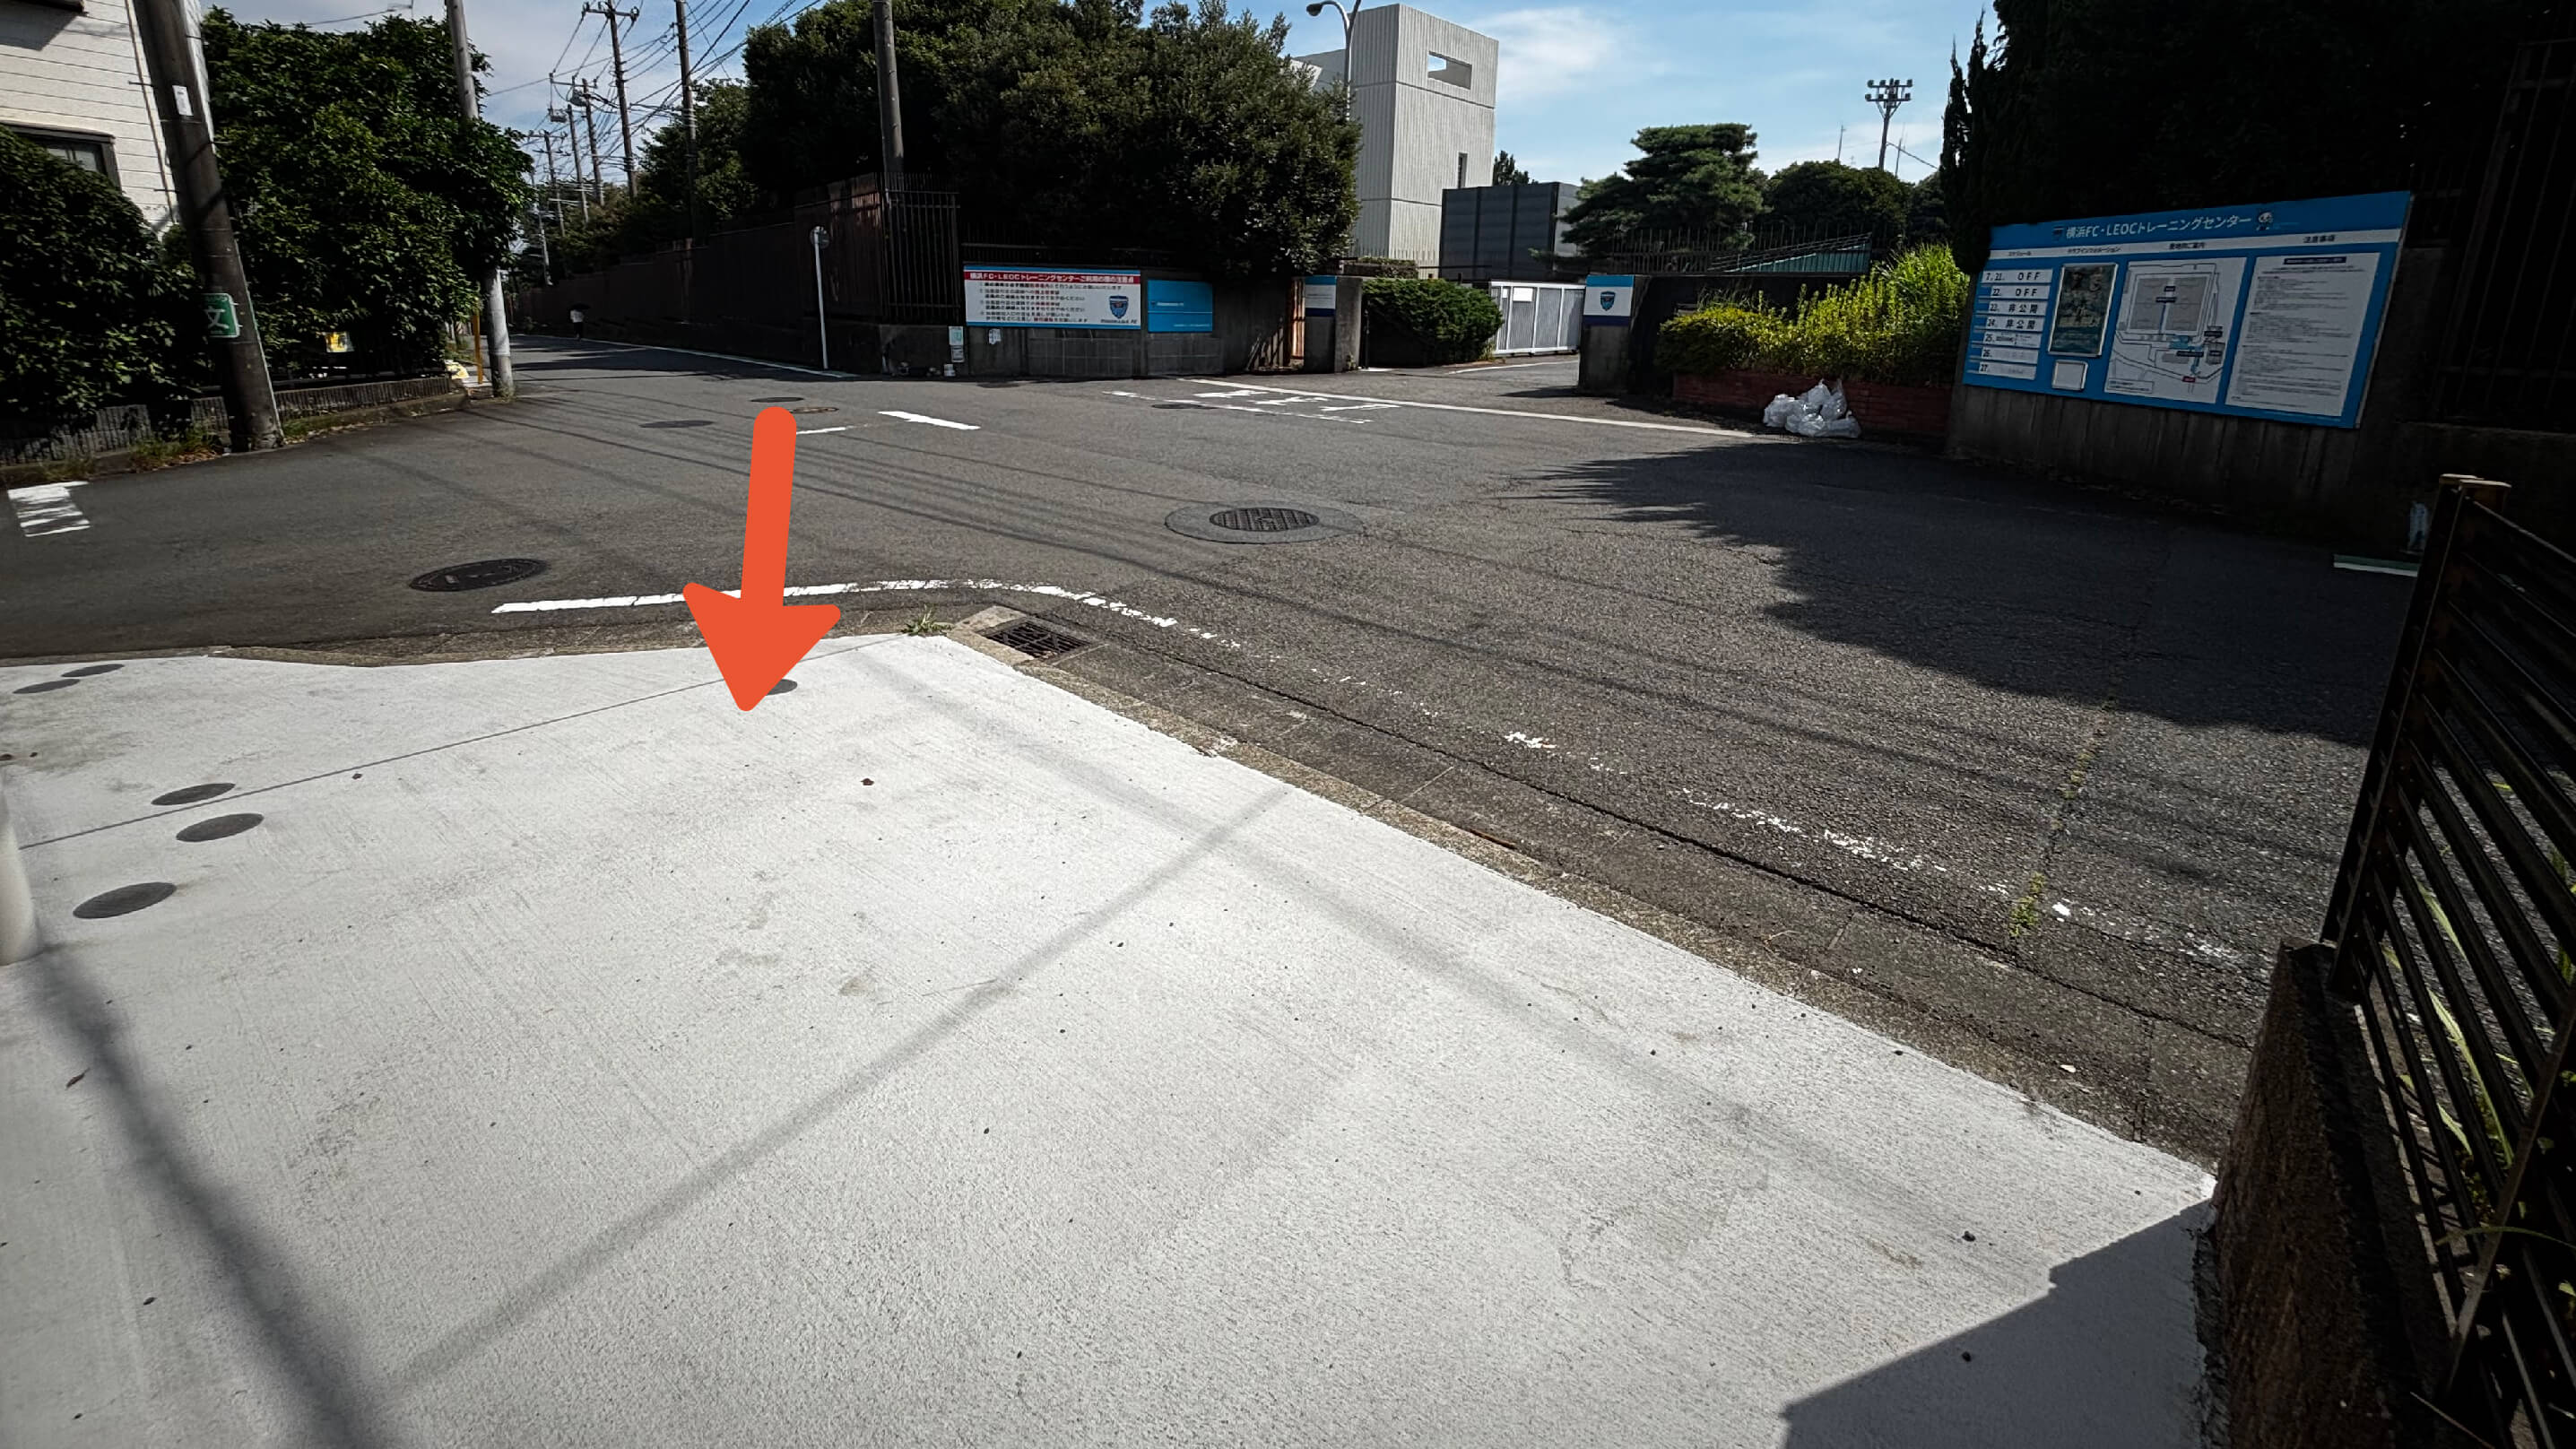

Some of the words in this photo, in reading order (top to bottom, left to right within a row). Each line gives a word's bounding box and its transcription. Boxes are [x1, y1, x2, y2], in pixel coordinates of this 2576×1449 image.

[2066, 215, 2252, 239] 横浜FC・LEOCトレーニングセンター
[2017, 272, 2041, 281] OFF
[2015, 288, 2037, 297] OFF
